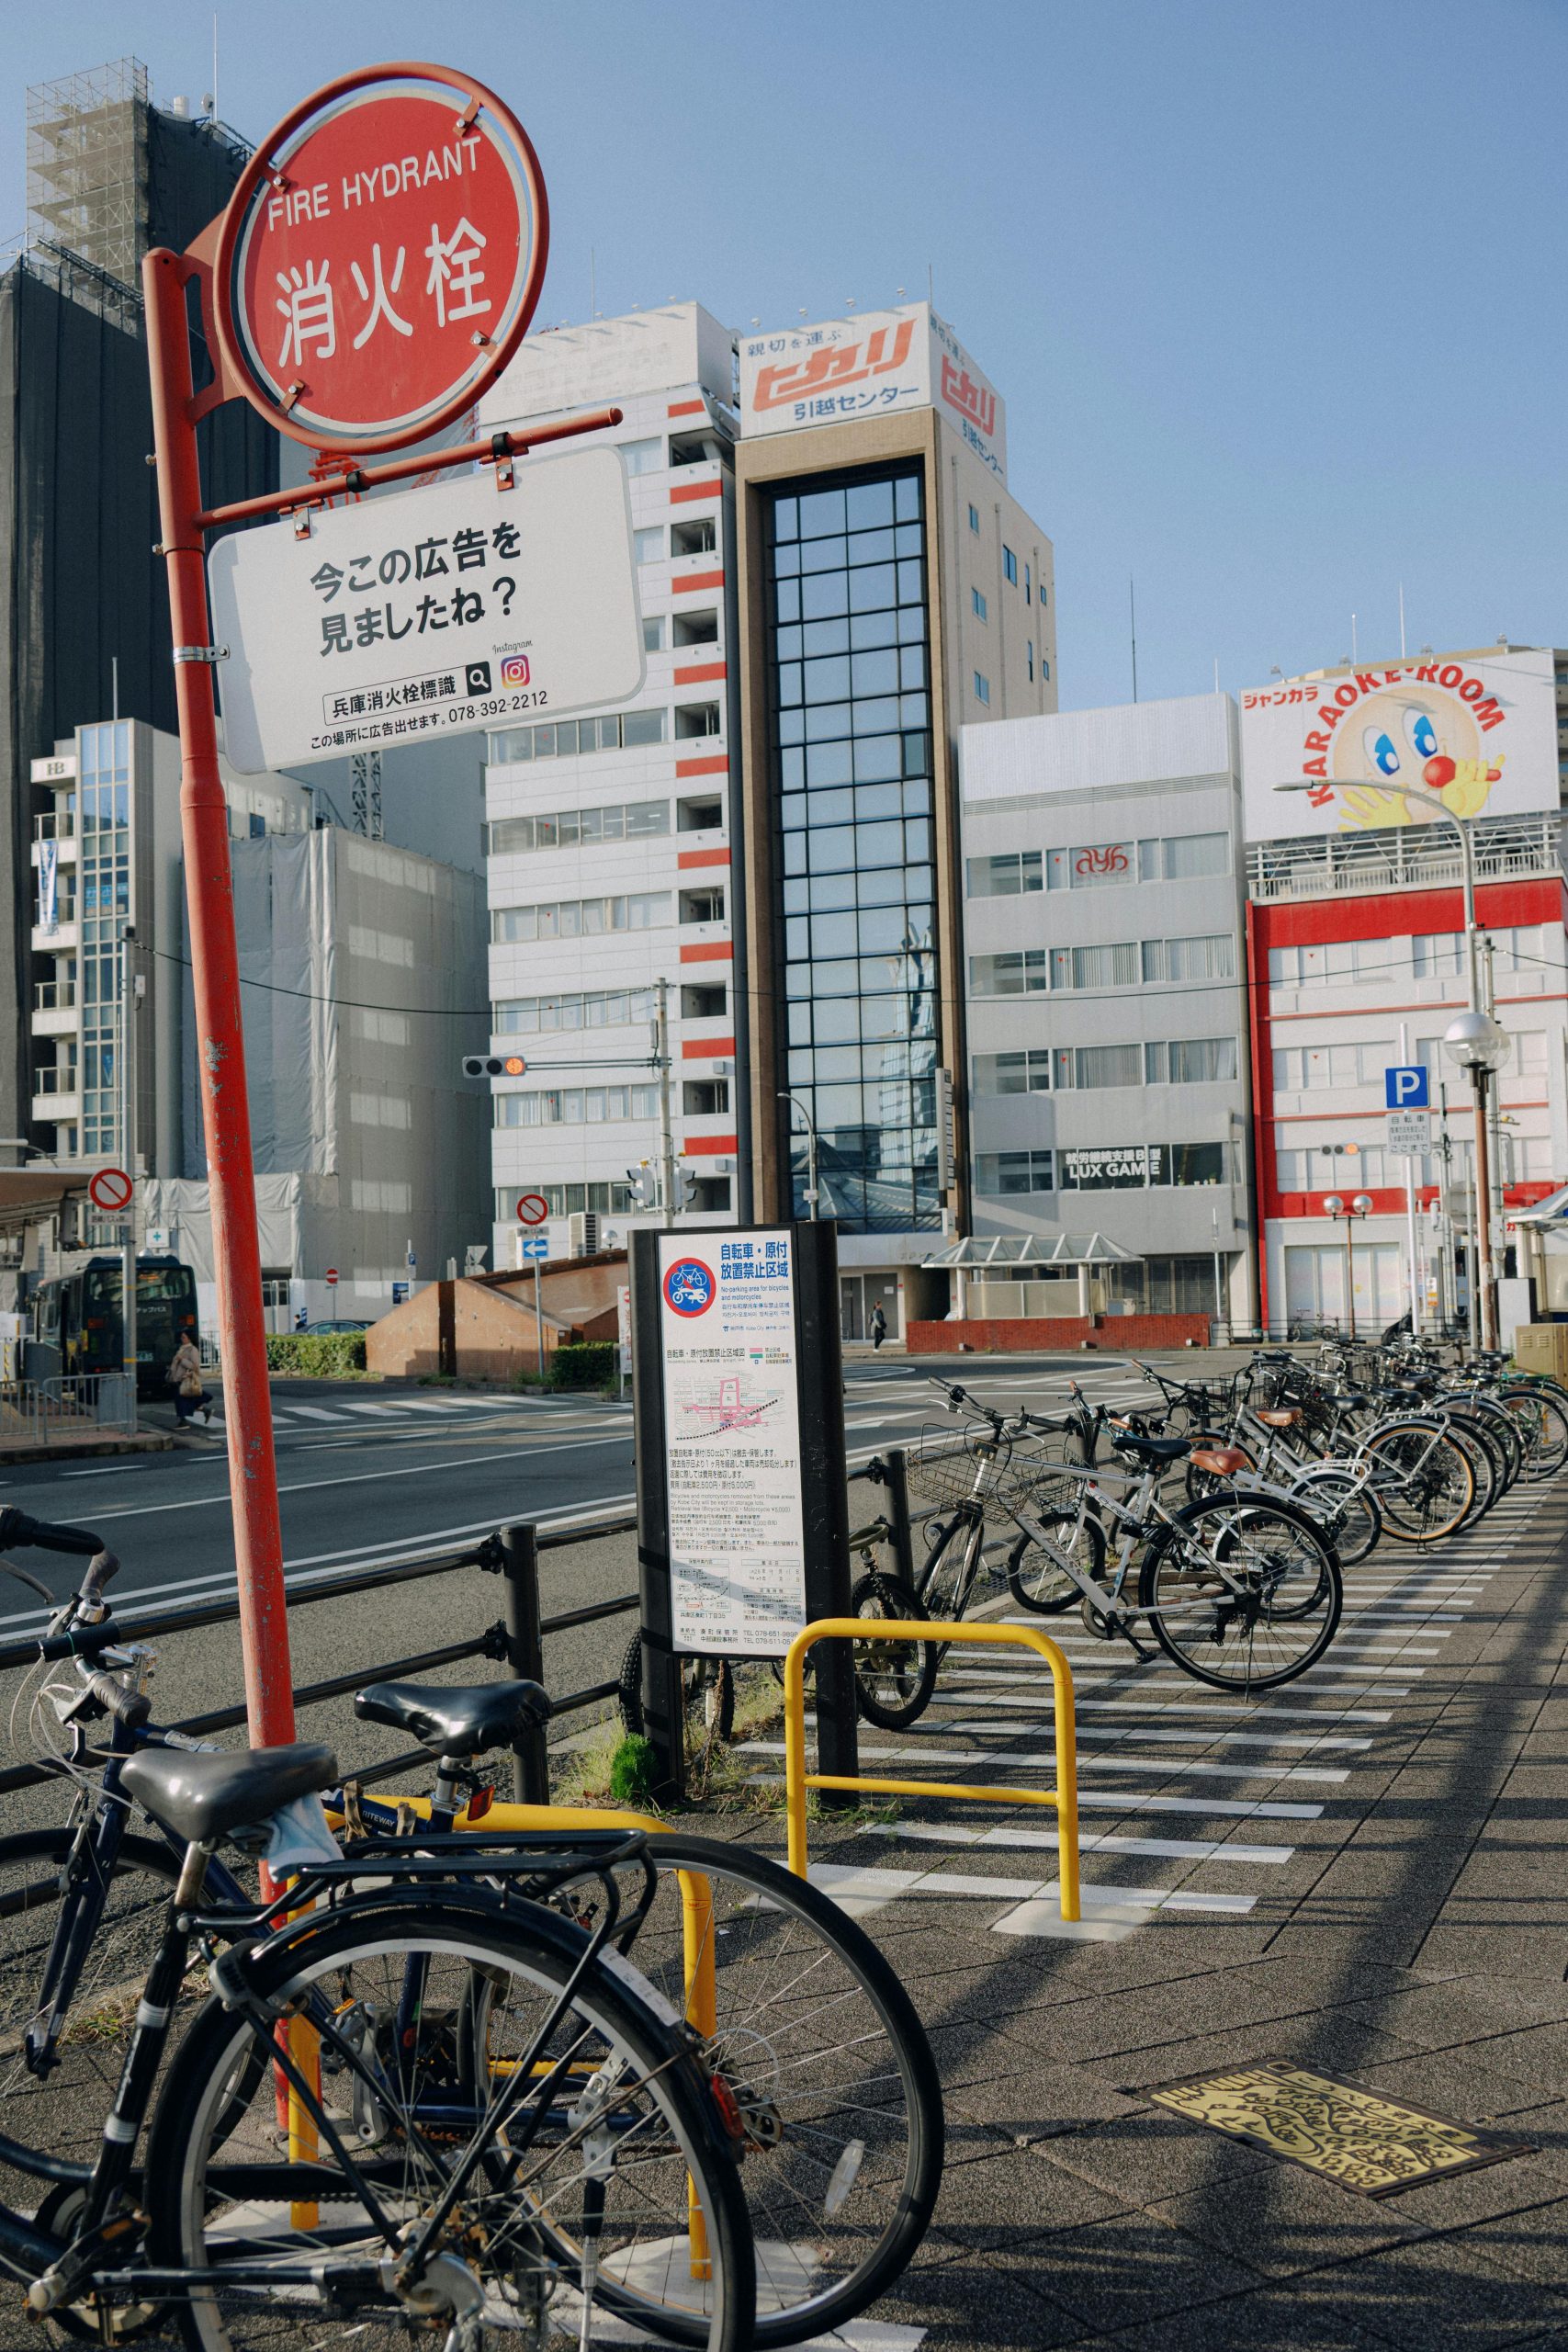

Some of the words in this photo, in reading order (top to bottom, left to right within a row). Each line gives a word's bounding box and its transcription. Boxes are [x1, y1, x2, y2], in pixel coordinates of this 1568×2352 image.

[267, 181, 331, 232] FIRE
[342, 136, 482, 211] HYDRANT
[276, 216, 493, 368] 消火栓
[748, 329, 843, 357] 親切を運ぶ
[752, 318, 918, 413] ヒカリ
[794, 385, 919, 421] 引越センター
[941, 353, 996, 437] ヒカリ
[310, 520, 523, 604] 今この広告を
[319, 576, 519, 658] 見ましたね？
[492, 639, 534, 655] Instagram
[333, 674, 457, 719] 兵庫消火栓標識
[1243, 685, 1320, 710] ジャンカラ
[1395, 1070, 1420, 1104] P
[1391, 1114, 1425, 1125] 自転車
[1391, 1144, 1428, 1153] ここまで
[1069, 1163, 1103, 1179] LUX
[1106, 1161, 1161, 1177] GAME
[720, 1241, 788, 1261] 自転車・原付
[720, 1261, 789, 1280] 放置禁止区域
[769, 1284, 789, 1293] bicycles
[362, 1810, 396, 1827] RITEWAY
